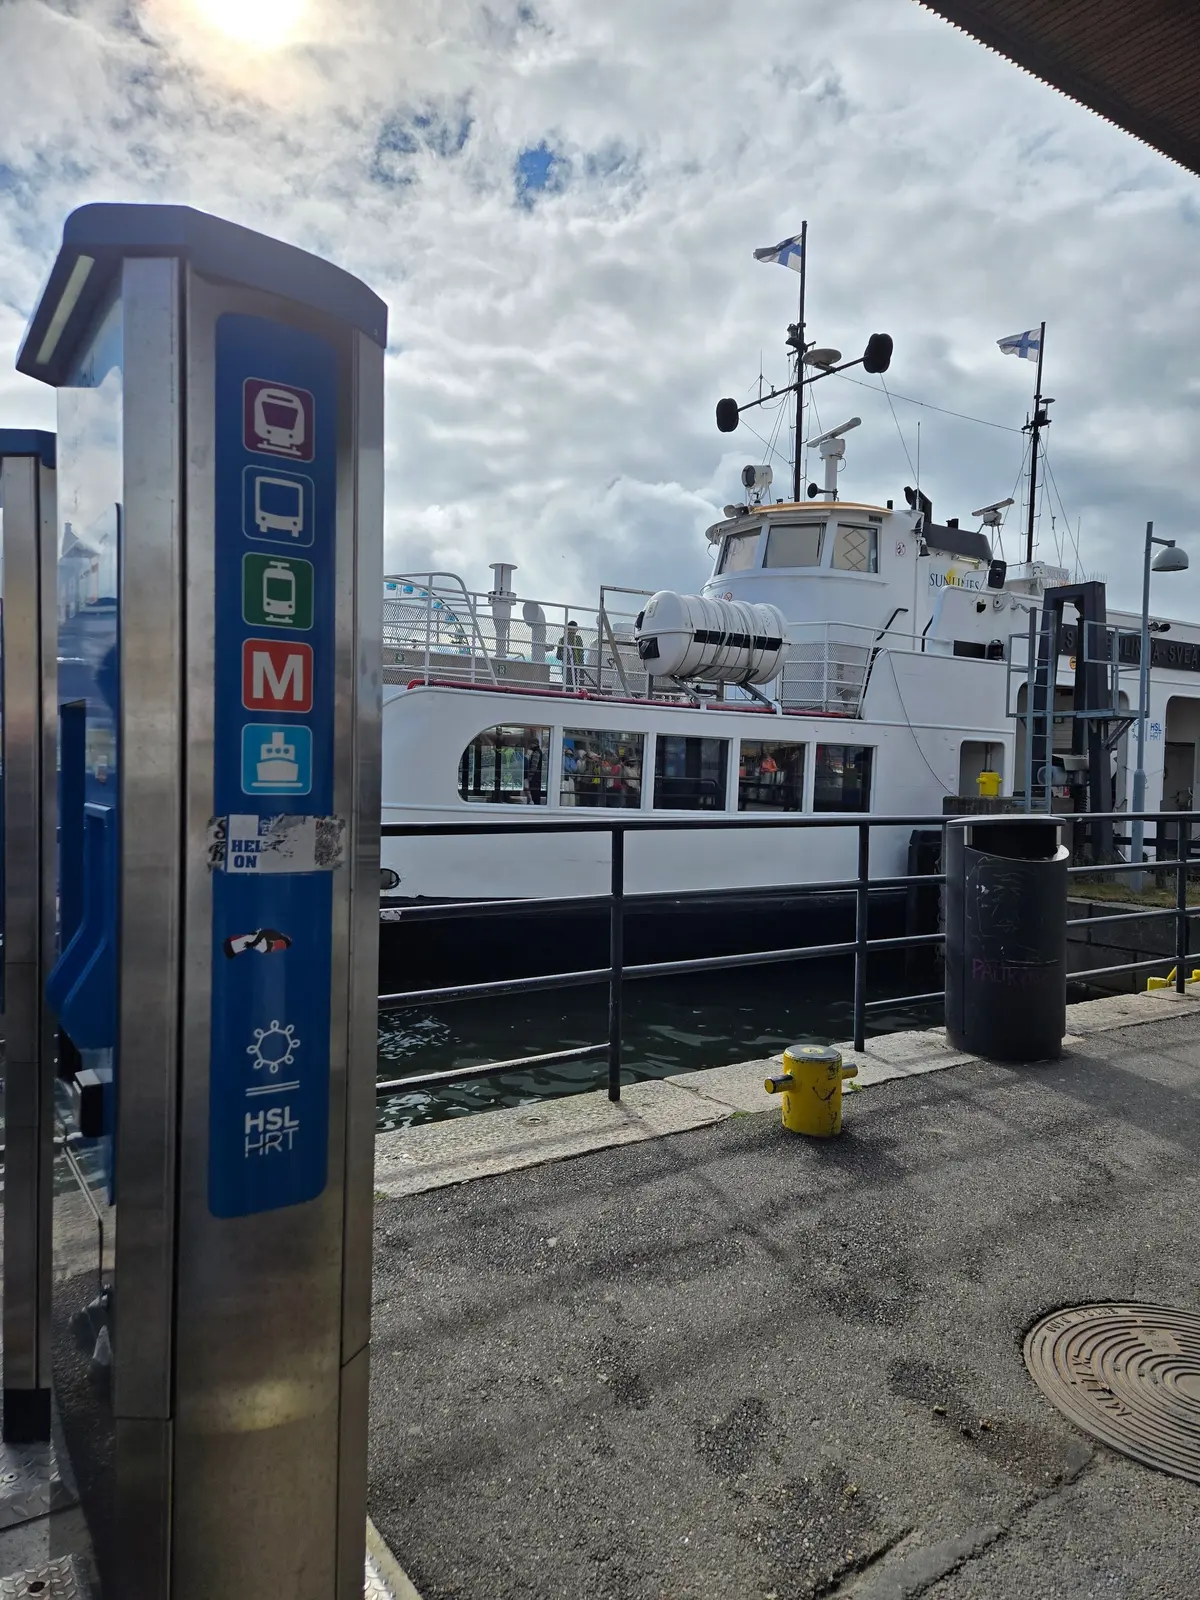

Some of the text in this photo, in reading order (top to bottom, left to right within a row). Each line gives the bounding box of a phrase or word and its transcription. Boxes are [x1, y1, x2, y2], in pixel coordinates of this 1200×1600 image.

[253, 651, 304, 702] M
[1150, 720, 1162, 732] HSL
[1150, 731, 1162, 741] HRT
[234, 854, 258, 868] ON
[245, 1106, 300, 1134] HSL
[245, 1127, 299, 1158] HRT
